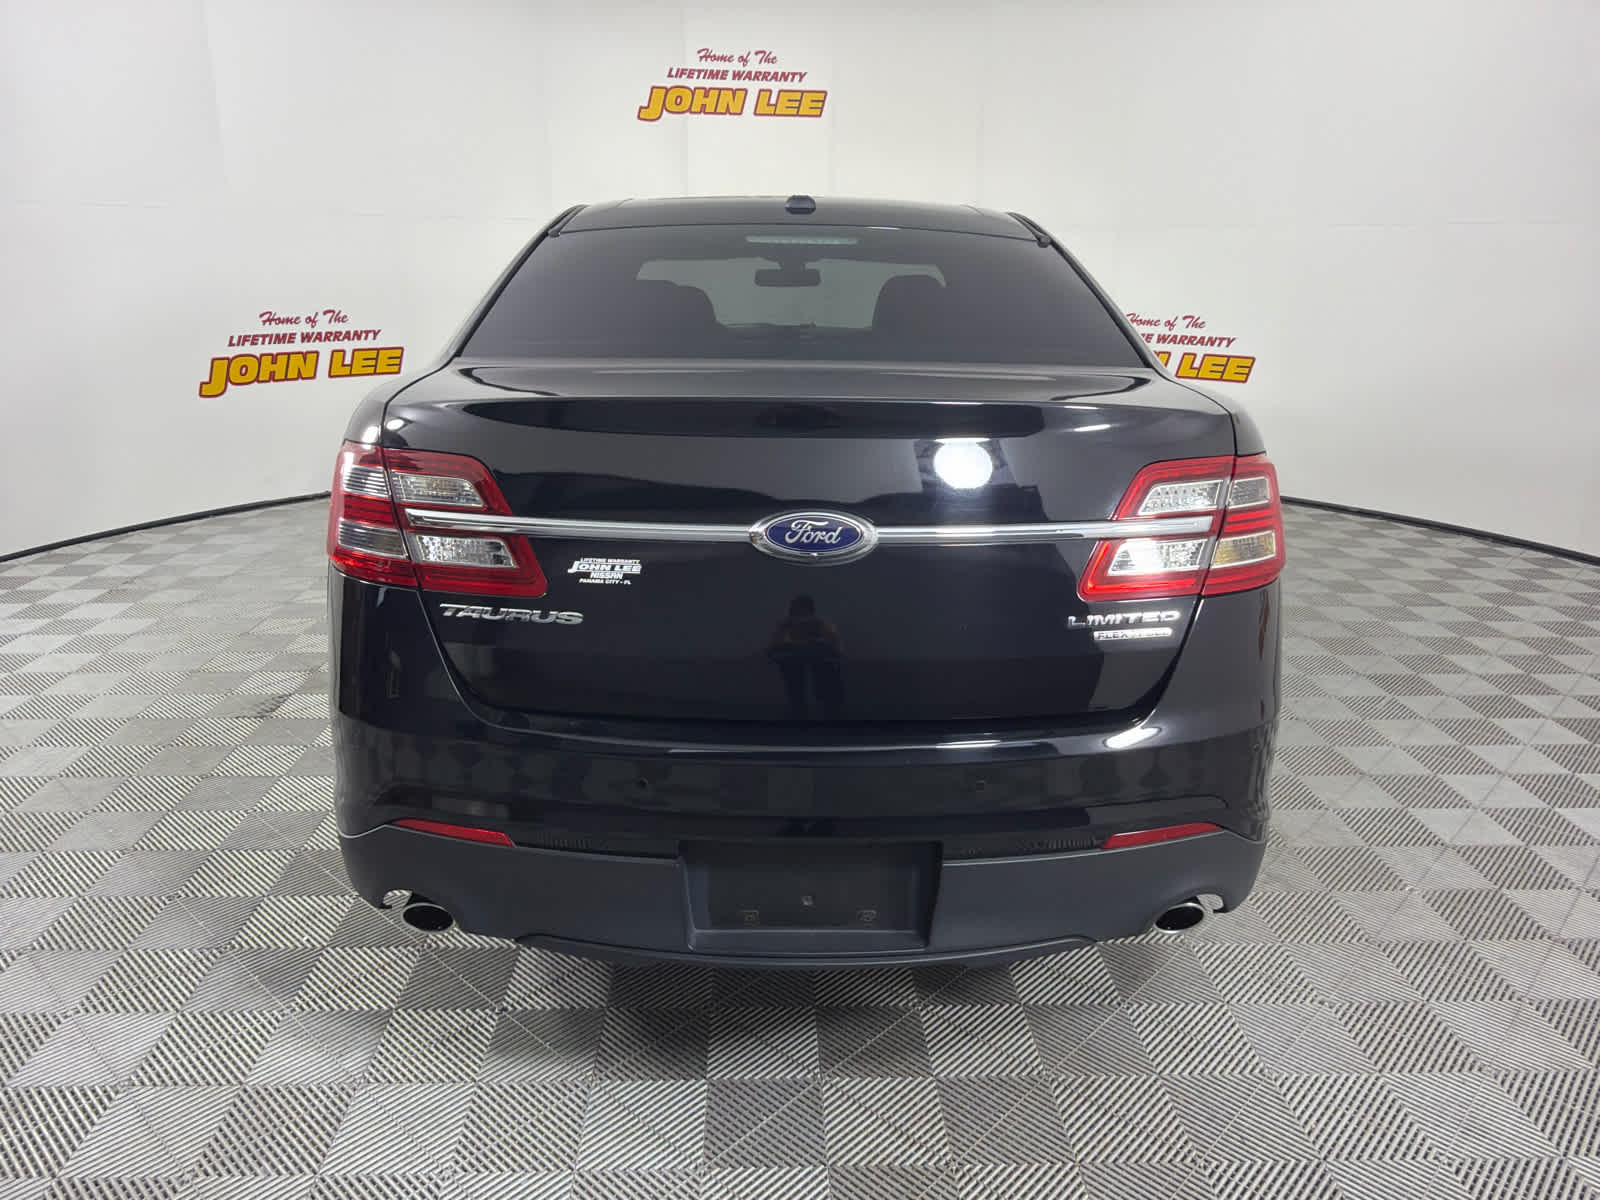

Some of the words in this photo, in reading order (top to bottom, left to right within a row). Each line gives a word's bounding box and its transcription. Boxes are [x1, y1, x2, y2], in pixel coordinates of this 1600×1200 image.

[697, 48, 734, 63] Home
[737, 51, 751, 67] of
[754, 50, 777, 65] The
[667, 67, 729, 80] LIFETIME
[732, 70, 807, 82] WARRANTY
[637, 85, 748, 121] JOHN
[753, 88, 828, 118] LEE
[259, 311, 300, 326] Home
[305, 312, 318, 328] of
[322, 309, 349, 324] The
[1164, 316, 1178, 331] of
[1182, 315, 1206, 329] The
[228, 332, 297, 347] LIFETIME
[300, 329, 381, 343] WARRANTY
[1156, 333, 1236, 348] WARRANTY
[199, 350, 320, 398] JOHN
[328, 347, 404, 378] LEE
[1175, 352, 1256, 384] LEE
[785, 519, 843, 544] Ford
[567, 560, 611, 573] JOHN
[614, 564, 642, 573] LEE
[440, 603, 584, 625] TAURUS
[1067, 610, 1181, 626] LIMITED
